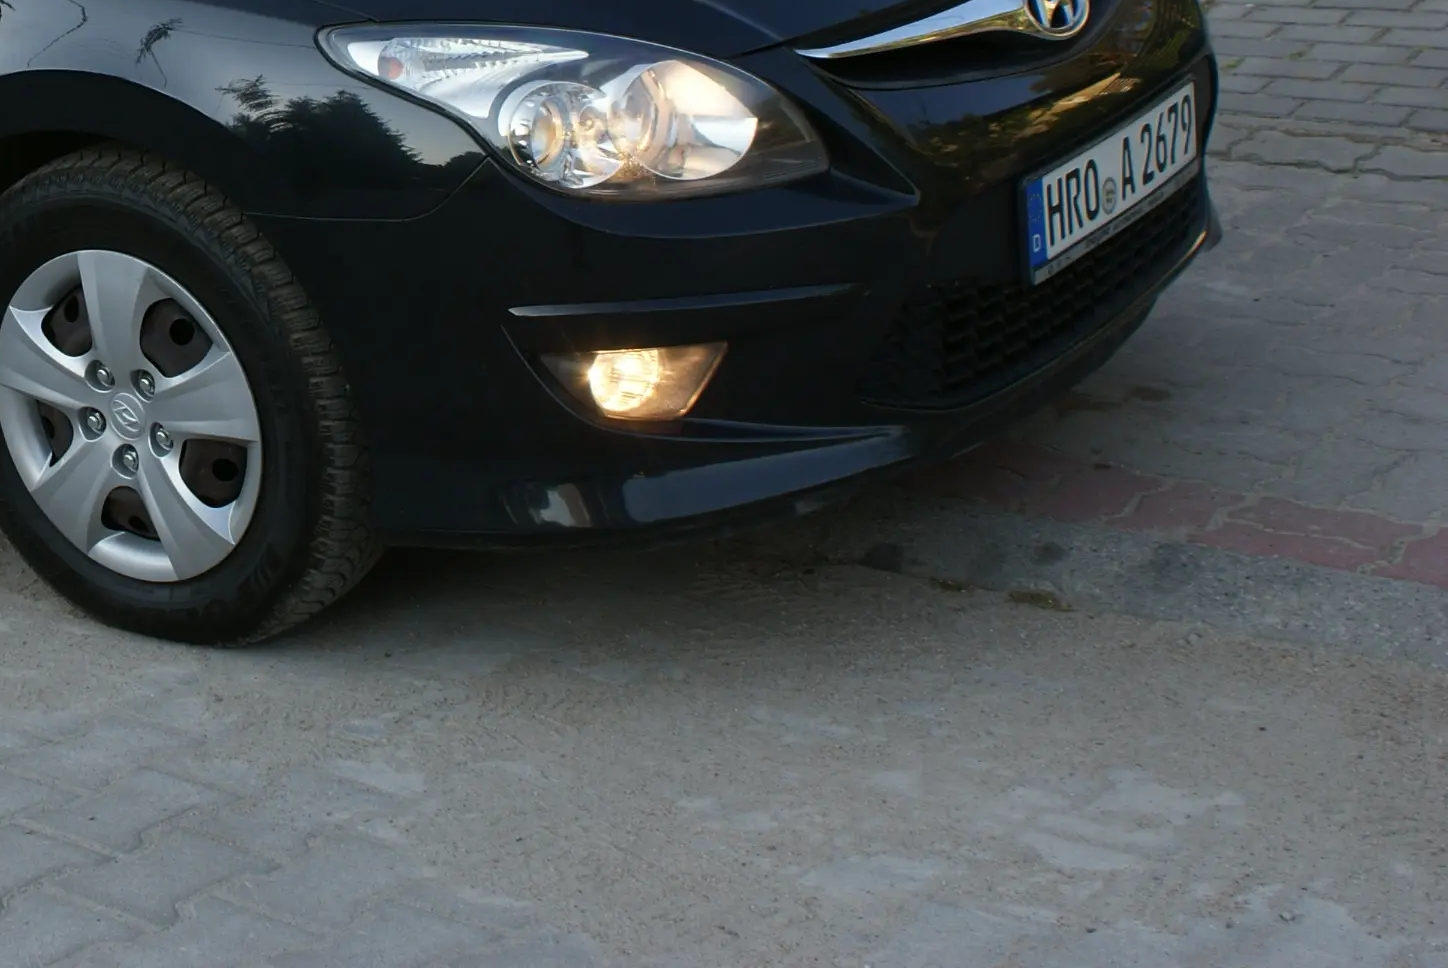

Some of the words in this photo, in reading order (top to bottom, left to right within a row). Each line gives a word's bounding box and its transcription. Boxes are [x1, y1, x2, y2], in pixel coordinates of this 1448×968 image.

[1046, 158, 1100, 247] HRO
[1121, 136, 1136, 201] A
[1139, 94, 1192, 185] 2679
